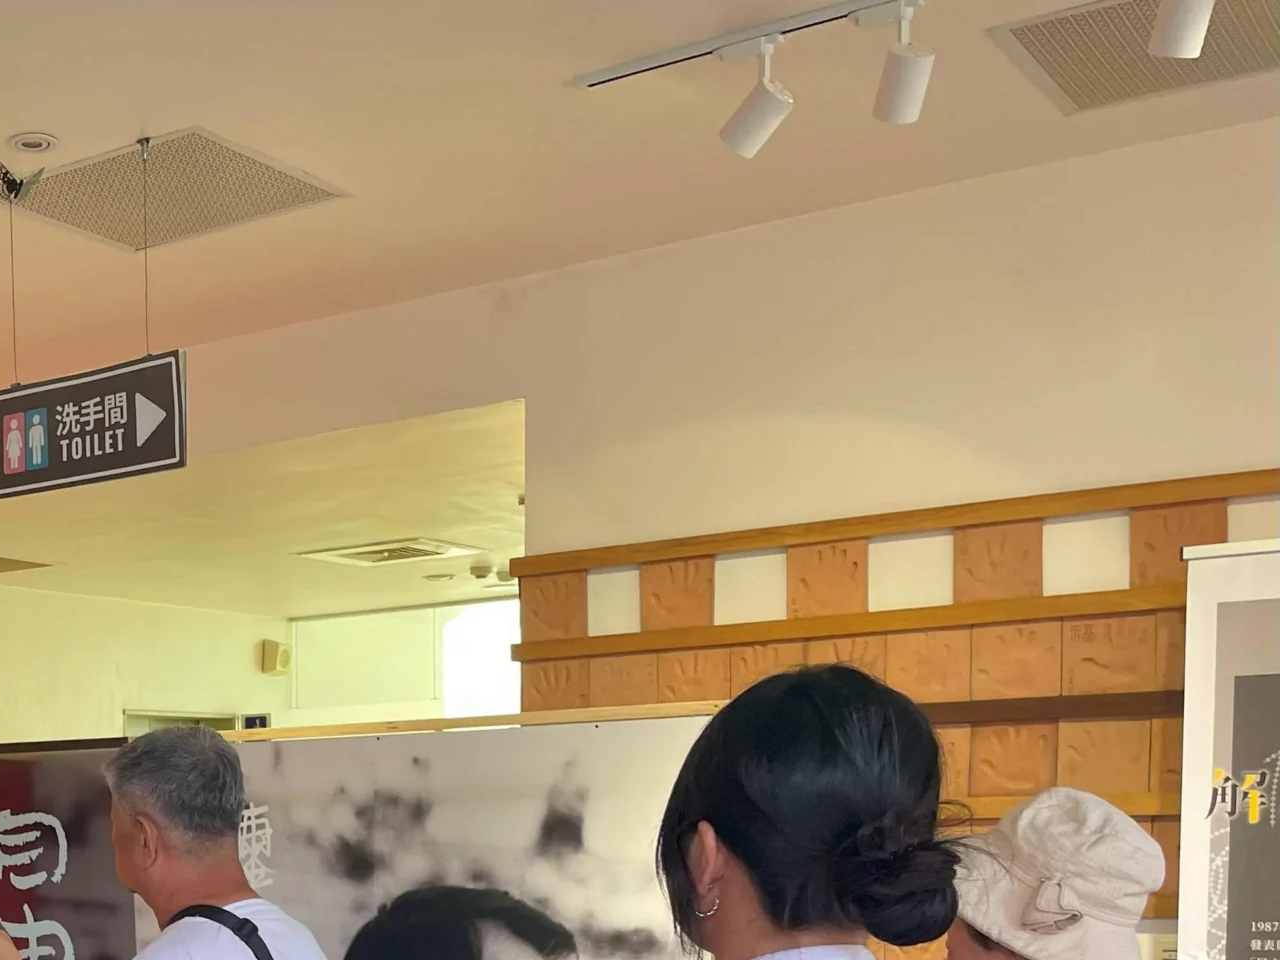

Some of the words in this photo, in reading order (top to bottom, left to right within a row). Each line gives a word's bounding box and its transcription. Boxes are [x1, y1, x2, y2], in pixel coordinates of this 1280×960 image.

[54, 391, 128, 437] 洗手間
[59, 428, 125, 462] TOILET
[1204, 766, 1269, 825] 解
[1251, 921, 1279, 932] 1987
